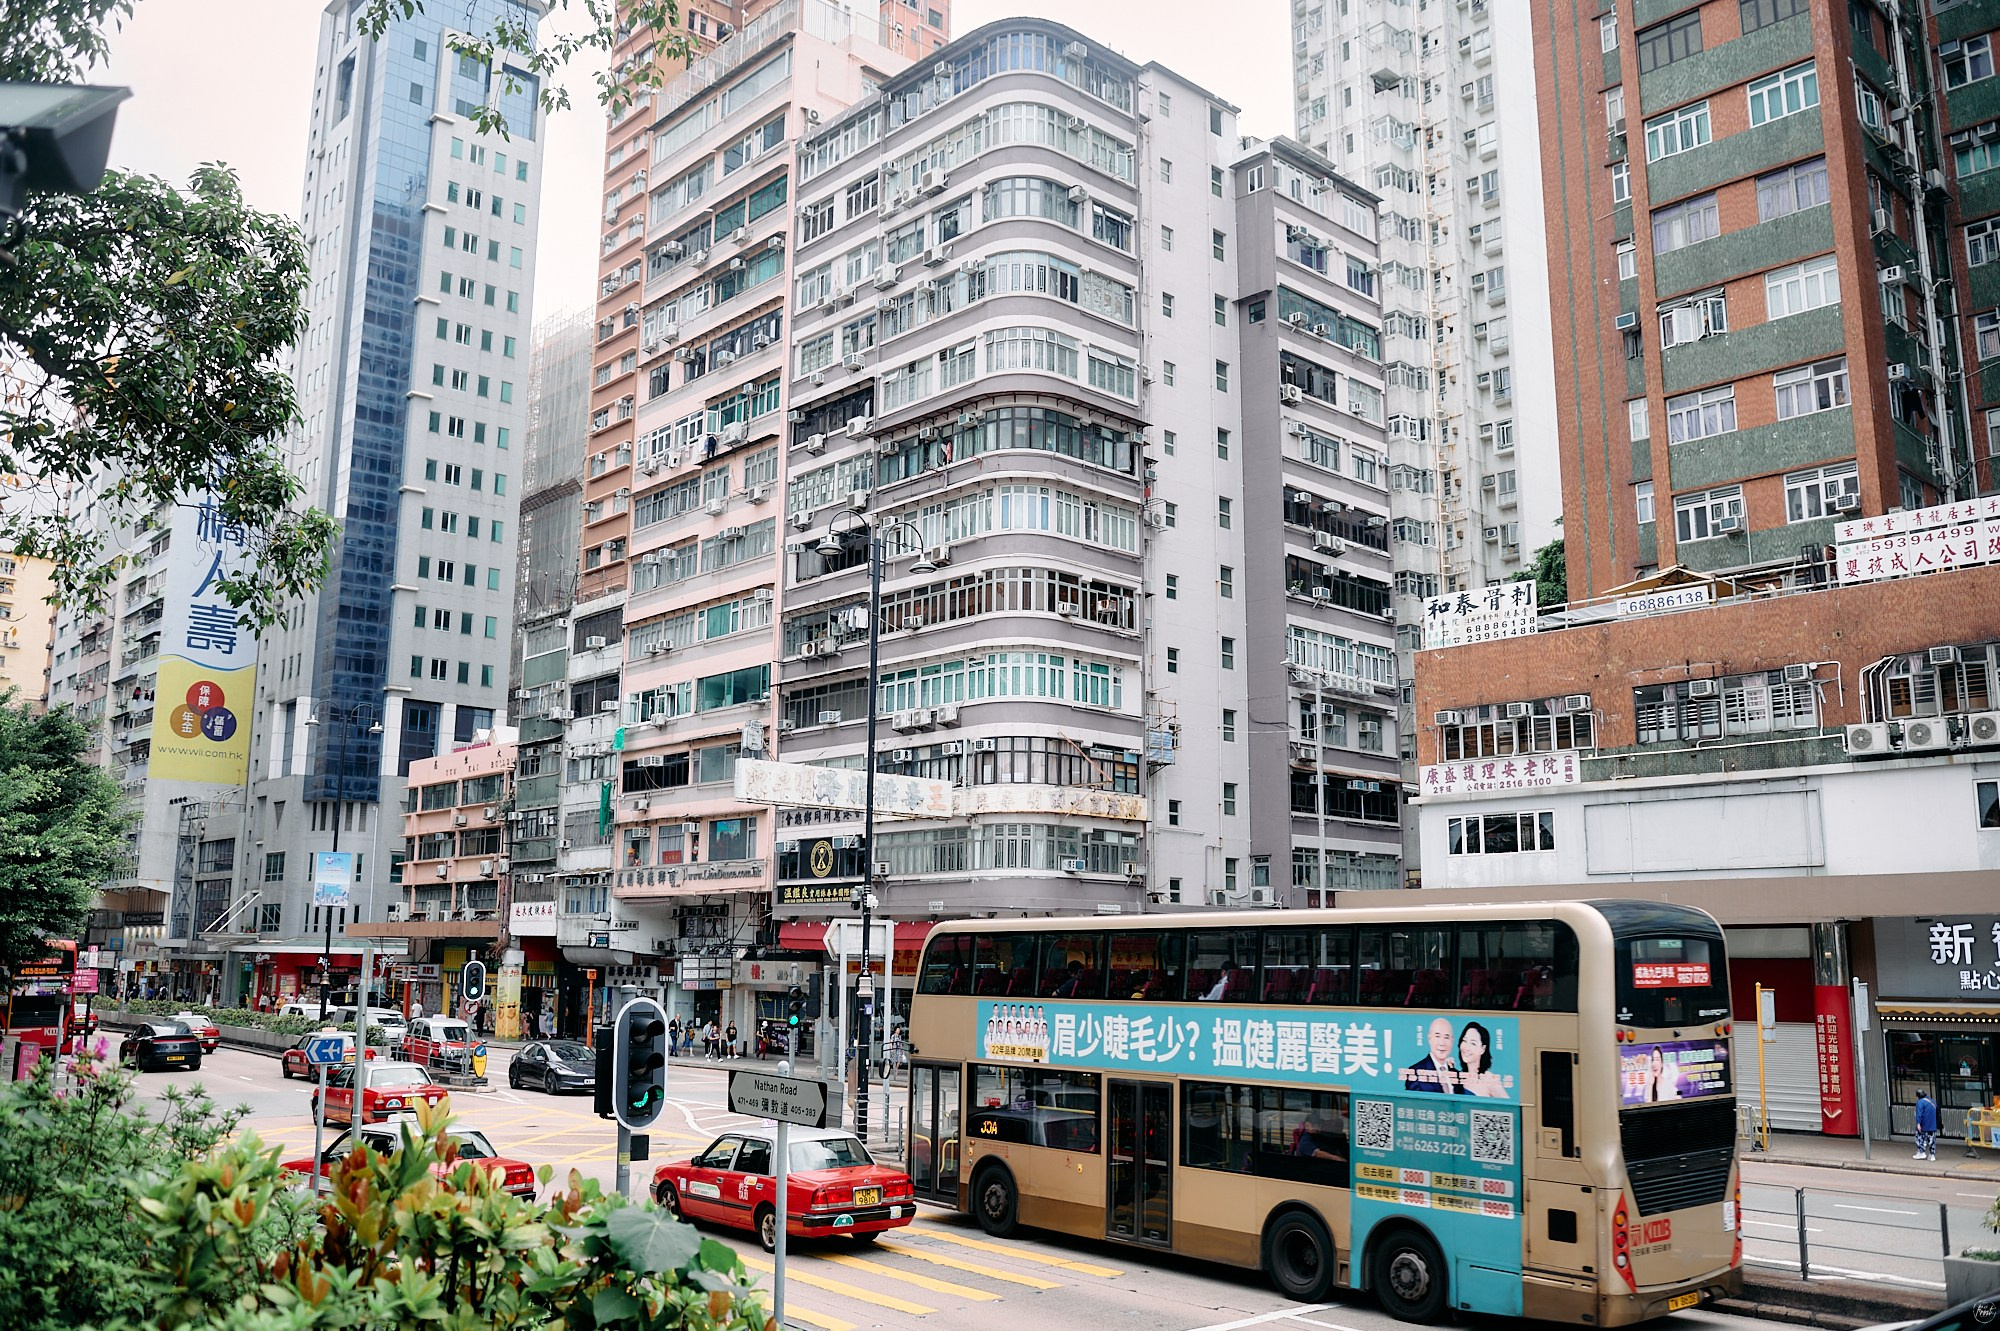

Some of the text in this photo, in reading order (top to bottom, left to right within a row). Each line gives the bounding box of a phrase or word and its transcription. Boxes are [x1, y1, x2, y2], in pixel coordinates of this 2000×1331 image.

[1871, 525, 1975, 552] 59394499
[1427, 583, 1532, 620] 和泰骨刺
[1629, 591, 1704, 612] 68886138
[1466, 616, 1535, 633] 68886138
[1466, 625, 1536, 642] 23951488
[197, 684, 211, 707] 保障
[181, 711, 194, 733] 年金
[1425, 757, 1559, 785] 康盛護理安老院
[1499, 777, 1552, 789] 2516 9100
[1959, 969, 2000, 990] 點心
[991, 1045, 1017, 1056] 22年品牌
[1052, 1013, 1393, 1077] 眉少睫毛少? 搵健麗醫美!
[1826, 1014, 1841, 1094] 歡迎光臨中華書局
[754, 1078, 798, 1096] Nathan Road
[761, 1097, 788, 1116] 彌敦道
[1414, 1140, 1467, 1156] 6263 2122
[1403, 1169, 1425, 1184] 3800
[861, 1189, 872, 1197] UR
[1483, 1179, 1506, 1195] 6800
[858, 1196, 876, 1205] 9810
[1643, 1218, 1671, 1245] KMB
